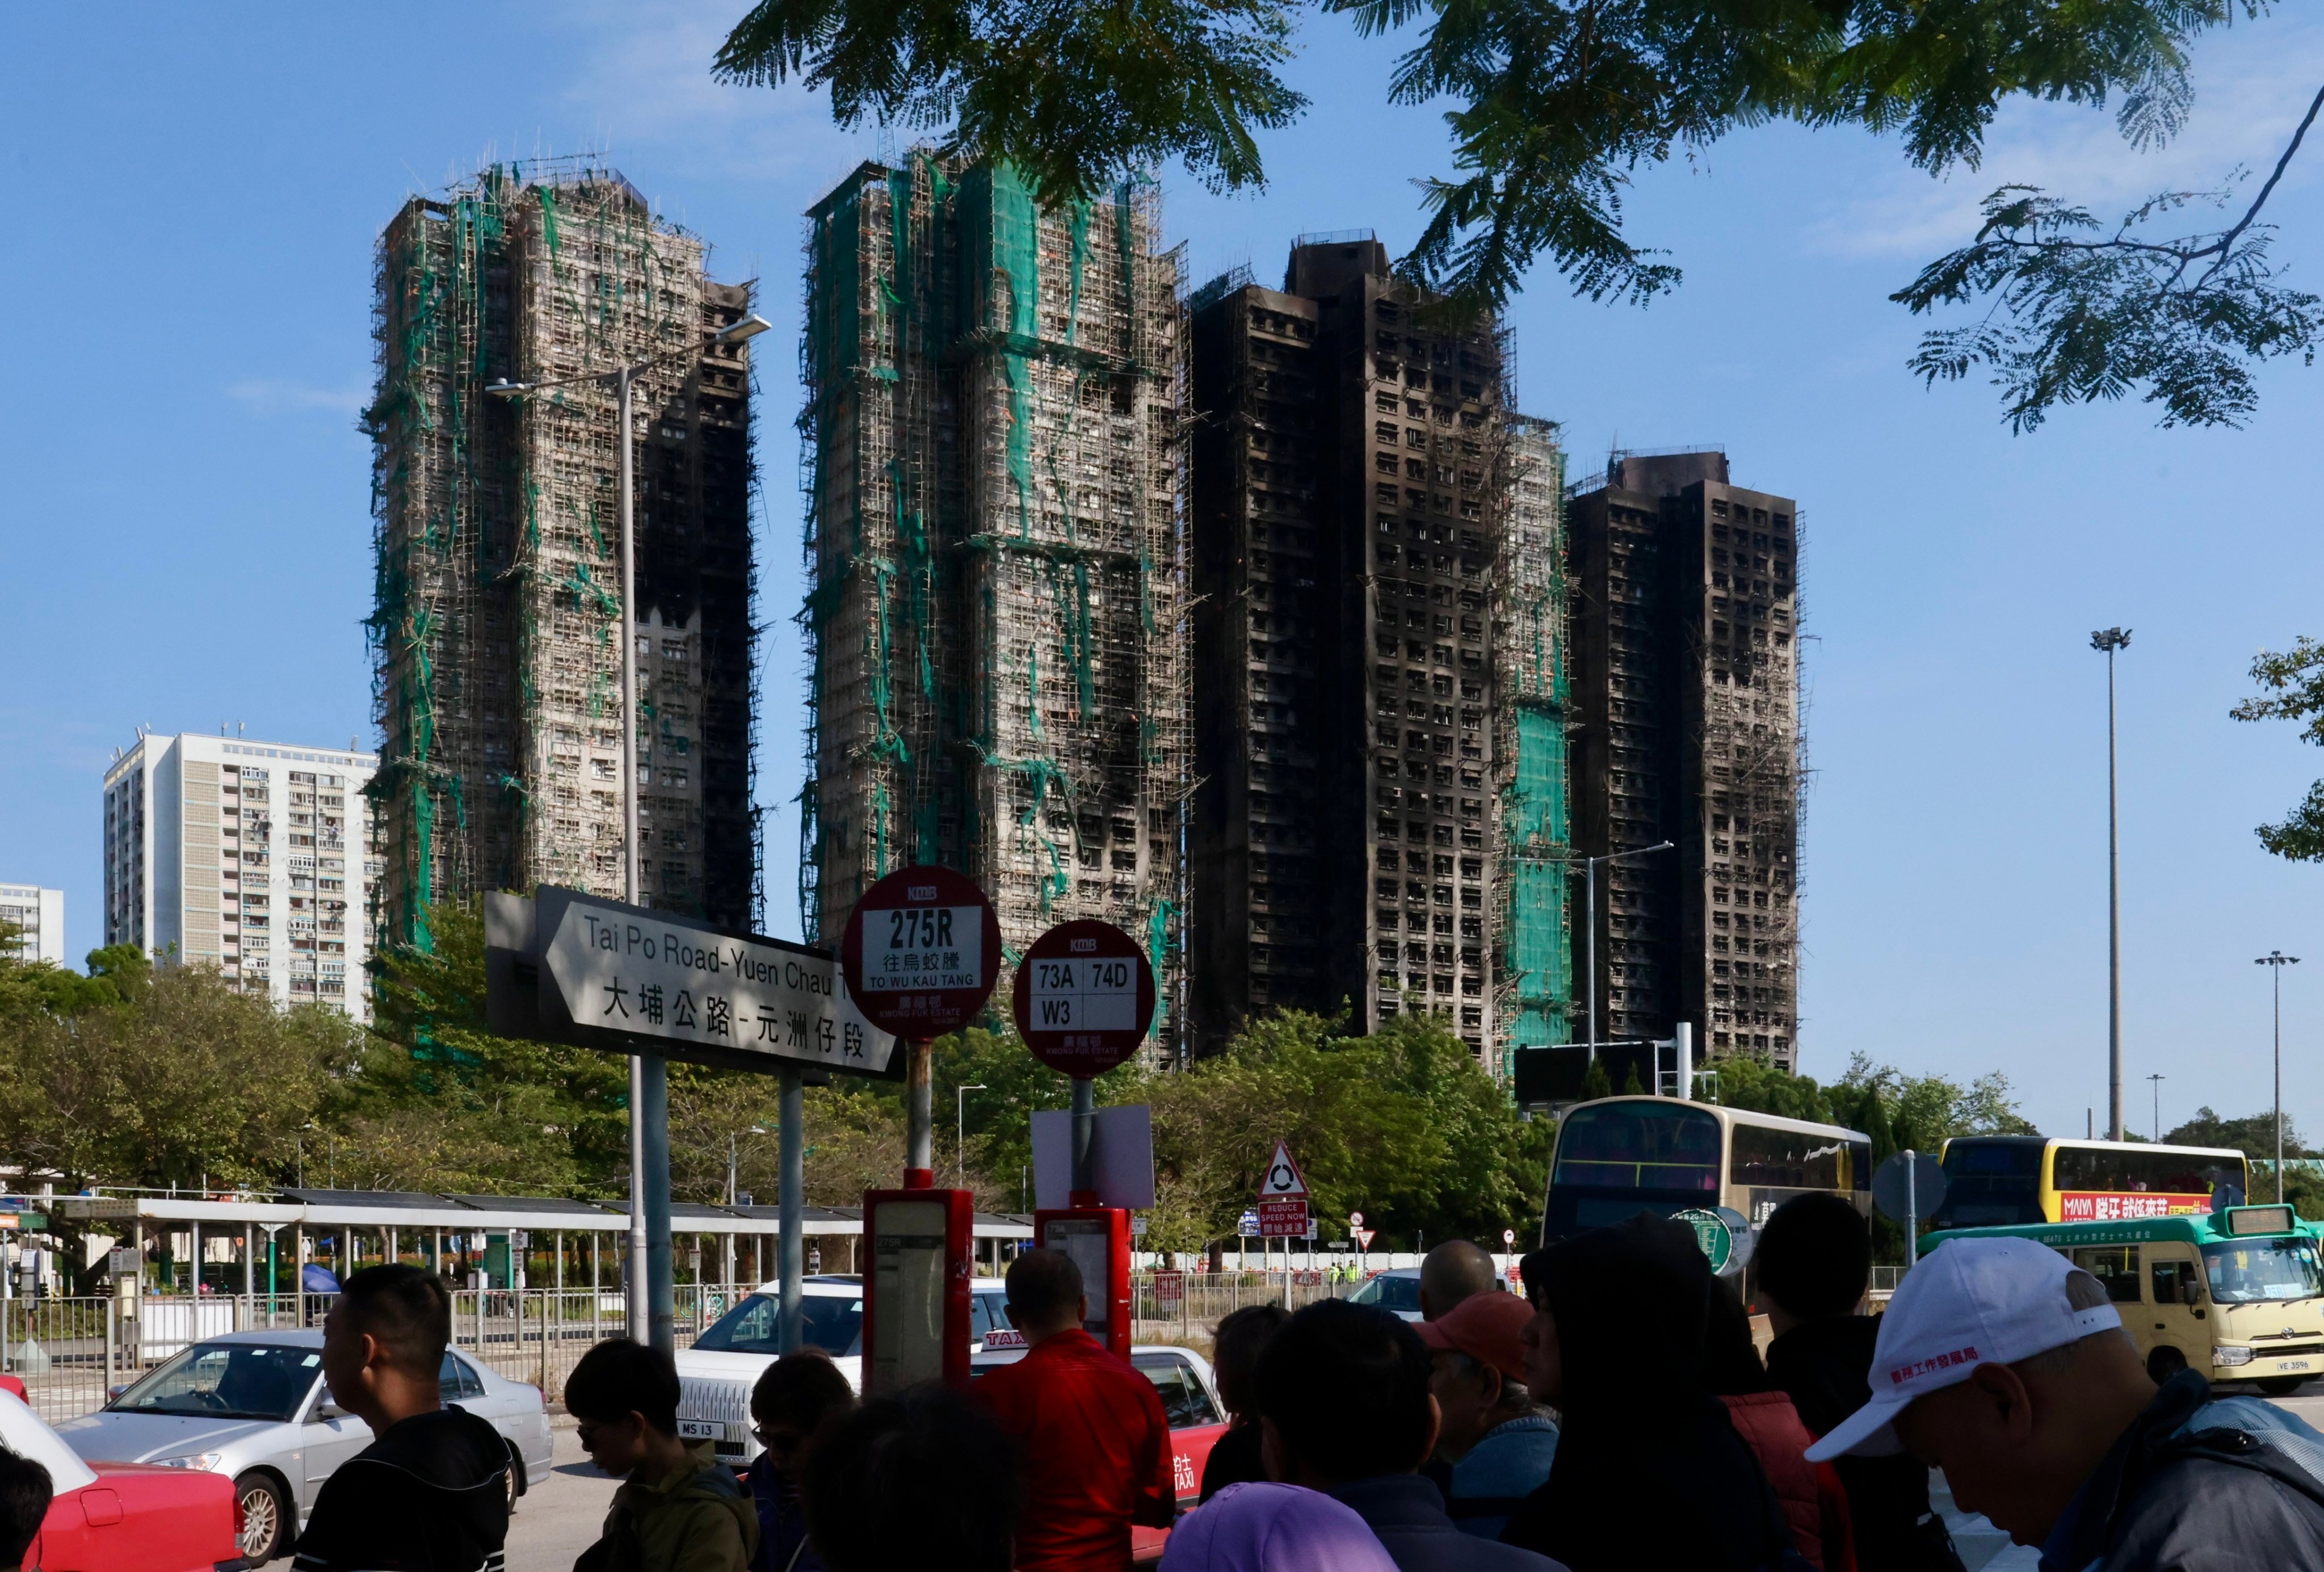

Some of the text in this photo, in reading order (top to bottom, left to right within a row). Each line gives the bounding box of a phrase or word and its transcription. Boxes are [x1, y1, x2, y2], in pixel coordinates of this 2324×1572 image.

[908, 886, 937, 901] KMB
[889, 909, 953, 948] 275R
[1070, 939, 1096, 951] KMB
[584, 915, 617, 952] Tai
[627, 924, 655, 959] Po
[785, 961, 831, 996] Chau
[883, 952, 960, 972] 往烏蛟騰
[871, 973, 973, 988] TO WU KAU TANG
[1040, 963, 1128, 988] 73A 74D
[880, 1007, 961, 1018] KWONG FUK ESTATE
[1042, 1000, 1070, 1025] W3
[1264, 1222, 1303, 1234] 開始減速
[878, 1237, 901, 1247] 275R
[986, 1333, 1025, 1345] TAX
[683, 1423, 712, 1435] MS 13
[1174, 1470, 1194, 1491] TAXI
